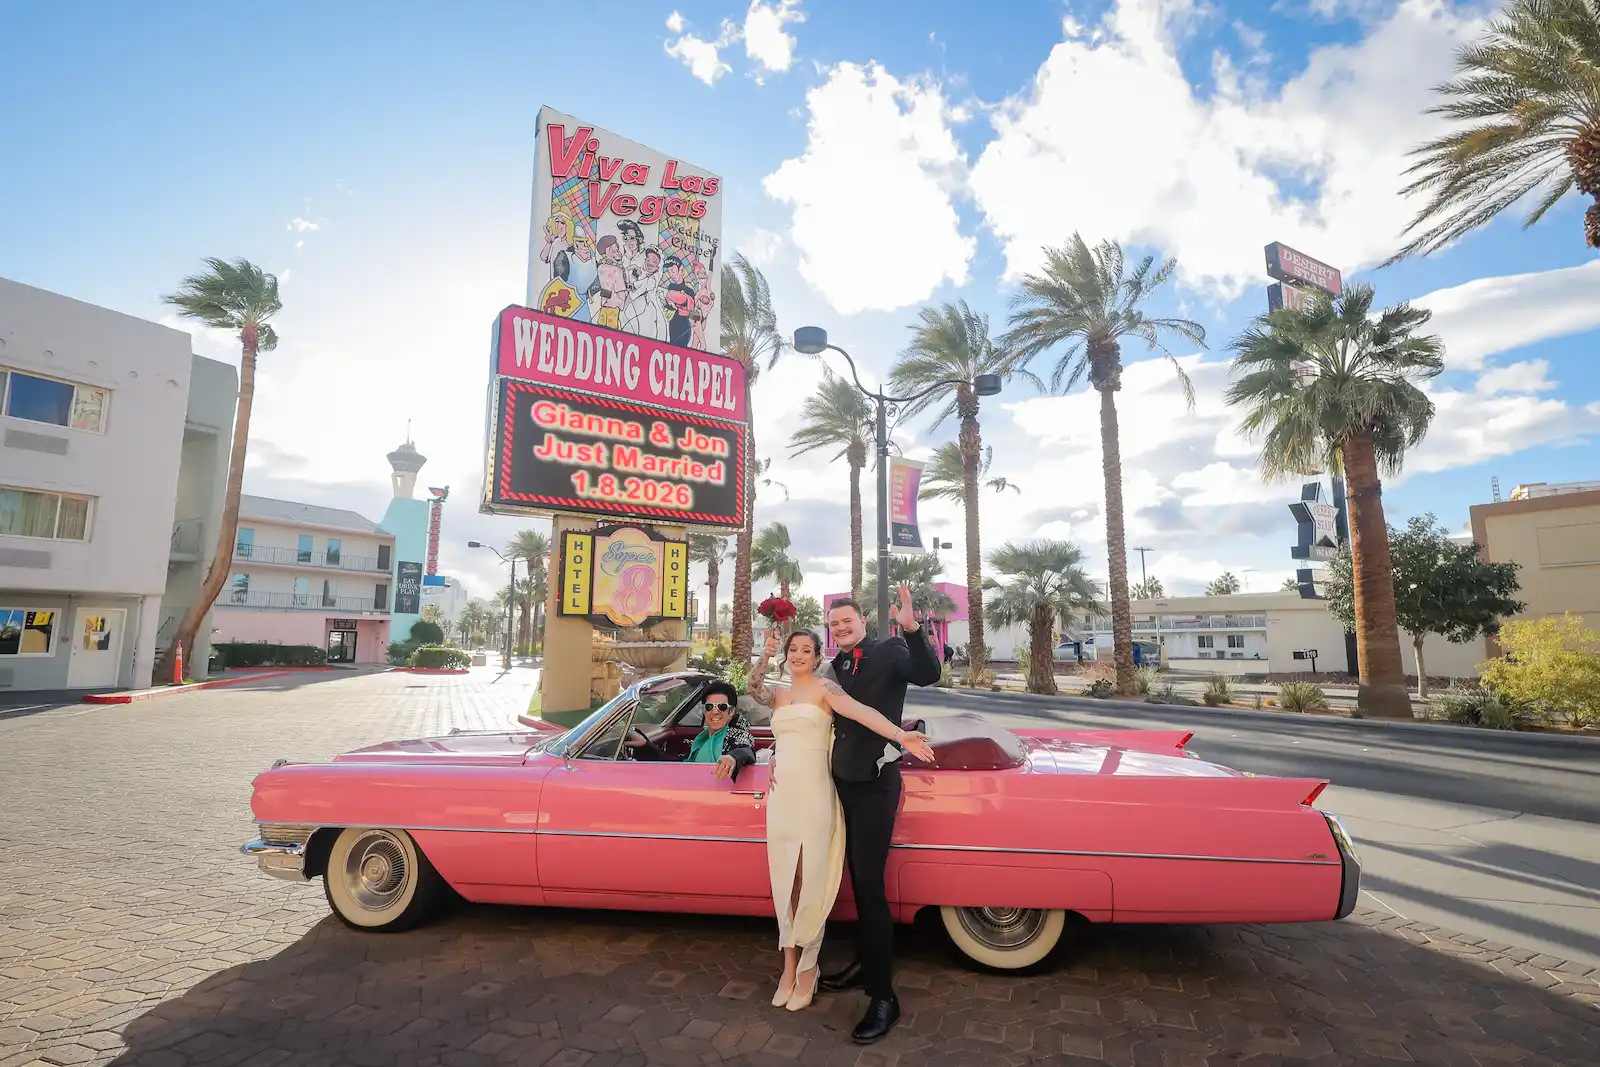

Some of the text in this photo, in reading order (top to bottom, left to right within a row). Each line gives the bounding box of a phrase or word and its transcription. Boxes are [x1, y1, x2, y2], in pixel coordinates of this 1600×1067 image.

[547, 124, 719, 196] Viva Las
[588, 181, 707, 225] Vegas
[667, 217, 720, 248] Wedding
[1283, 249, 1335, 280] DESERT
[1294, 266, 1328, 288] STAR
[513, 316, 736, 412] WEDDING CHAPEL
[531, 400, 728, 456] Gianna & Jon
[533, 433, 725, 484] Just Married
[571, 470, 694, 508] 1.8.2026
[572, 541, 583, 608] HOTEL
[602, 540, 657, 573] Super
[670, 549, 679, 611] HOTEL
[612, 564, 656, 616] 8
